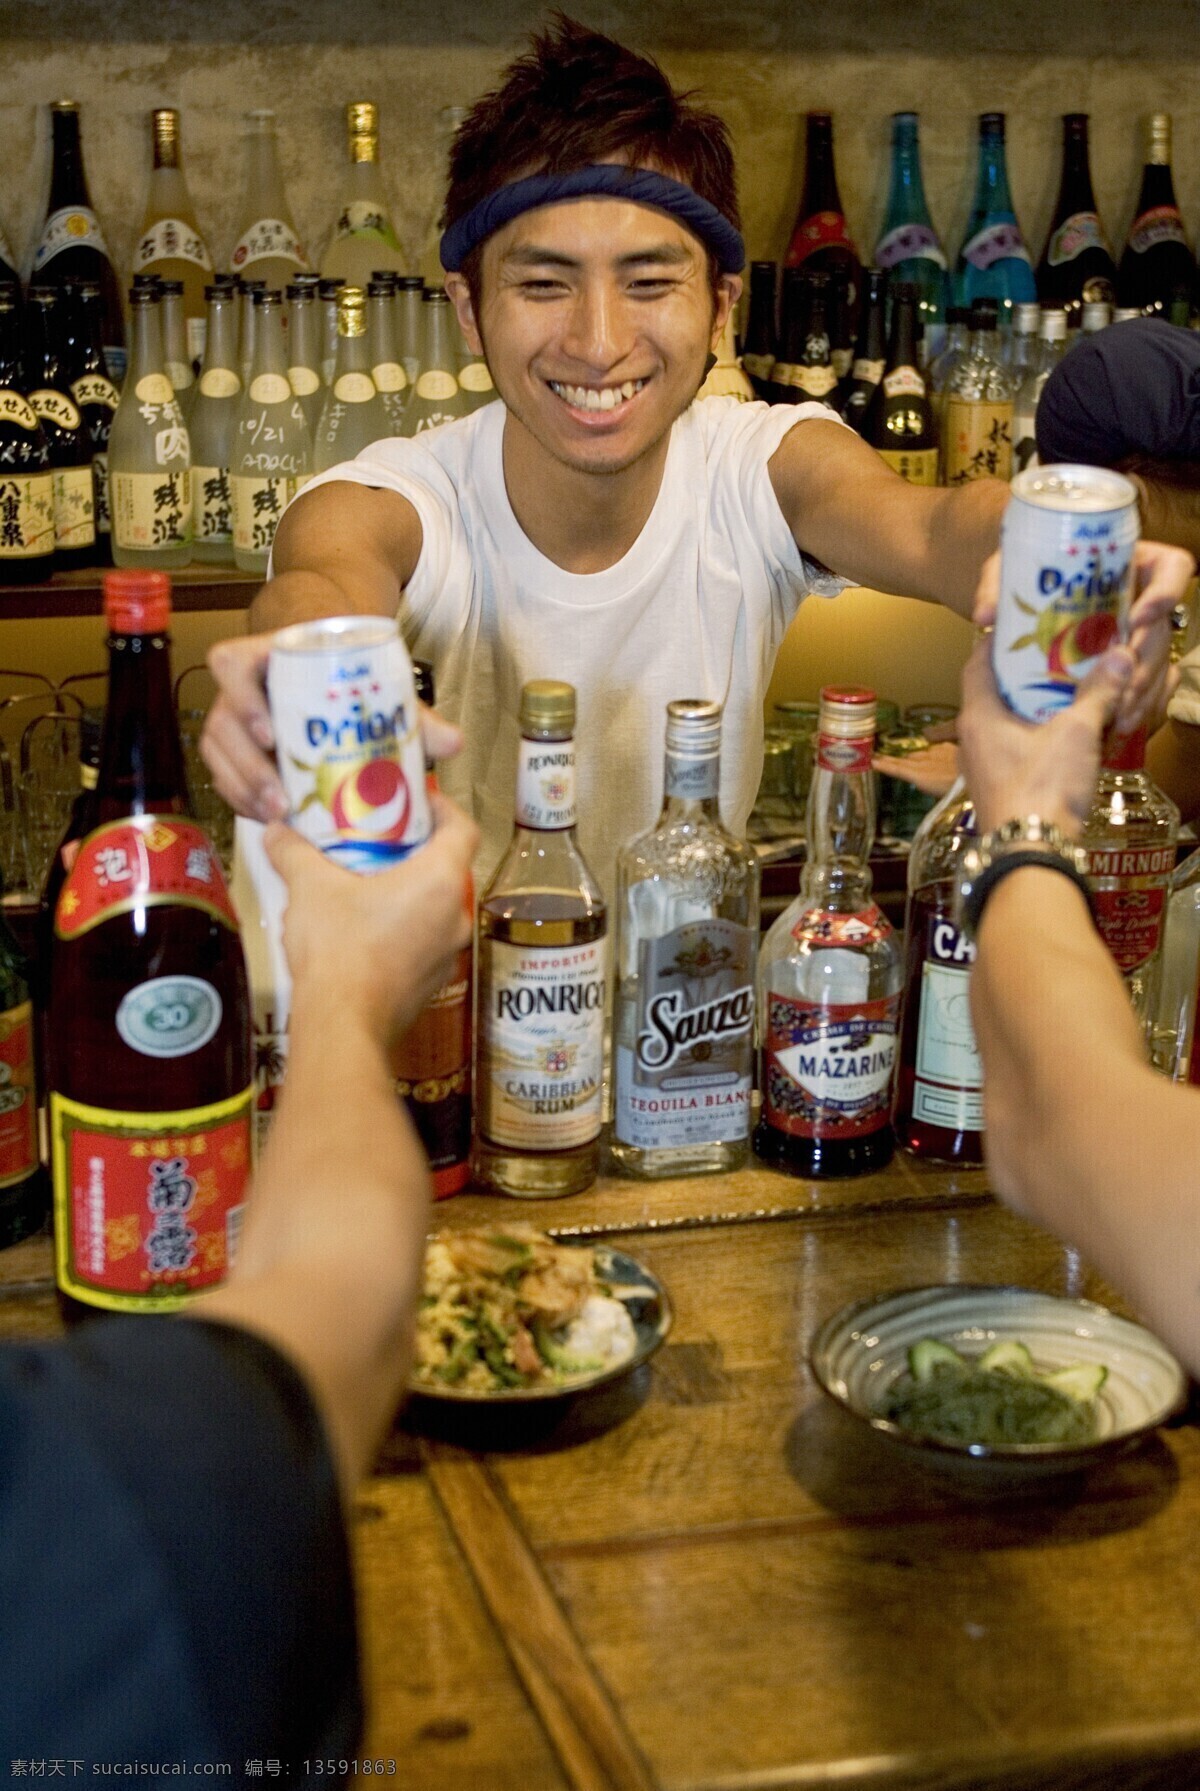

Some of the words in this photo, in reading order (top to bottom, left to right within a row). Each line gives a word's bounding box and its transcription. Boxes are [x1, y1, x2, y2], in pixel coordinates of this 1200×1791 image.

[153, 473, 185, 544] 残波
[637, 989, 752, 1068] Sauza
[506, 1077, 597, 1098] CARIBBEAN
[535, 1098, 575, 1115] RUM
[630, 1096, 698, 1113] TEQUILA
